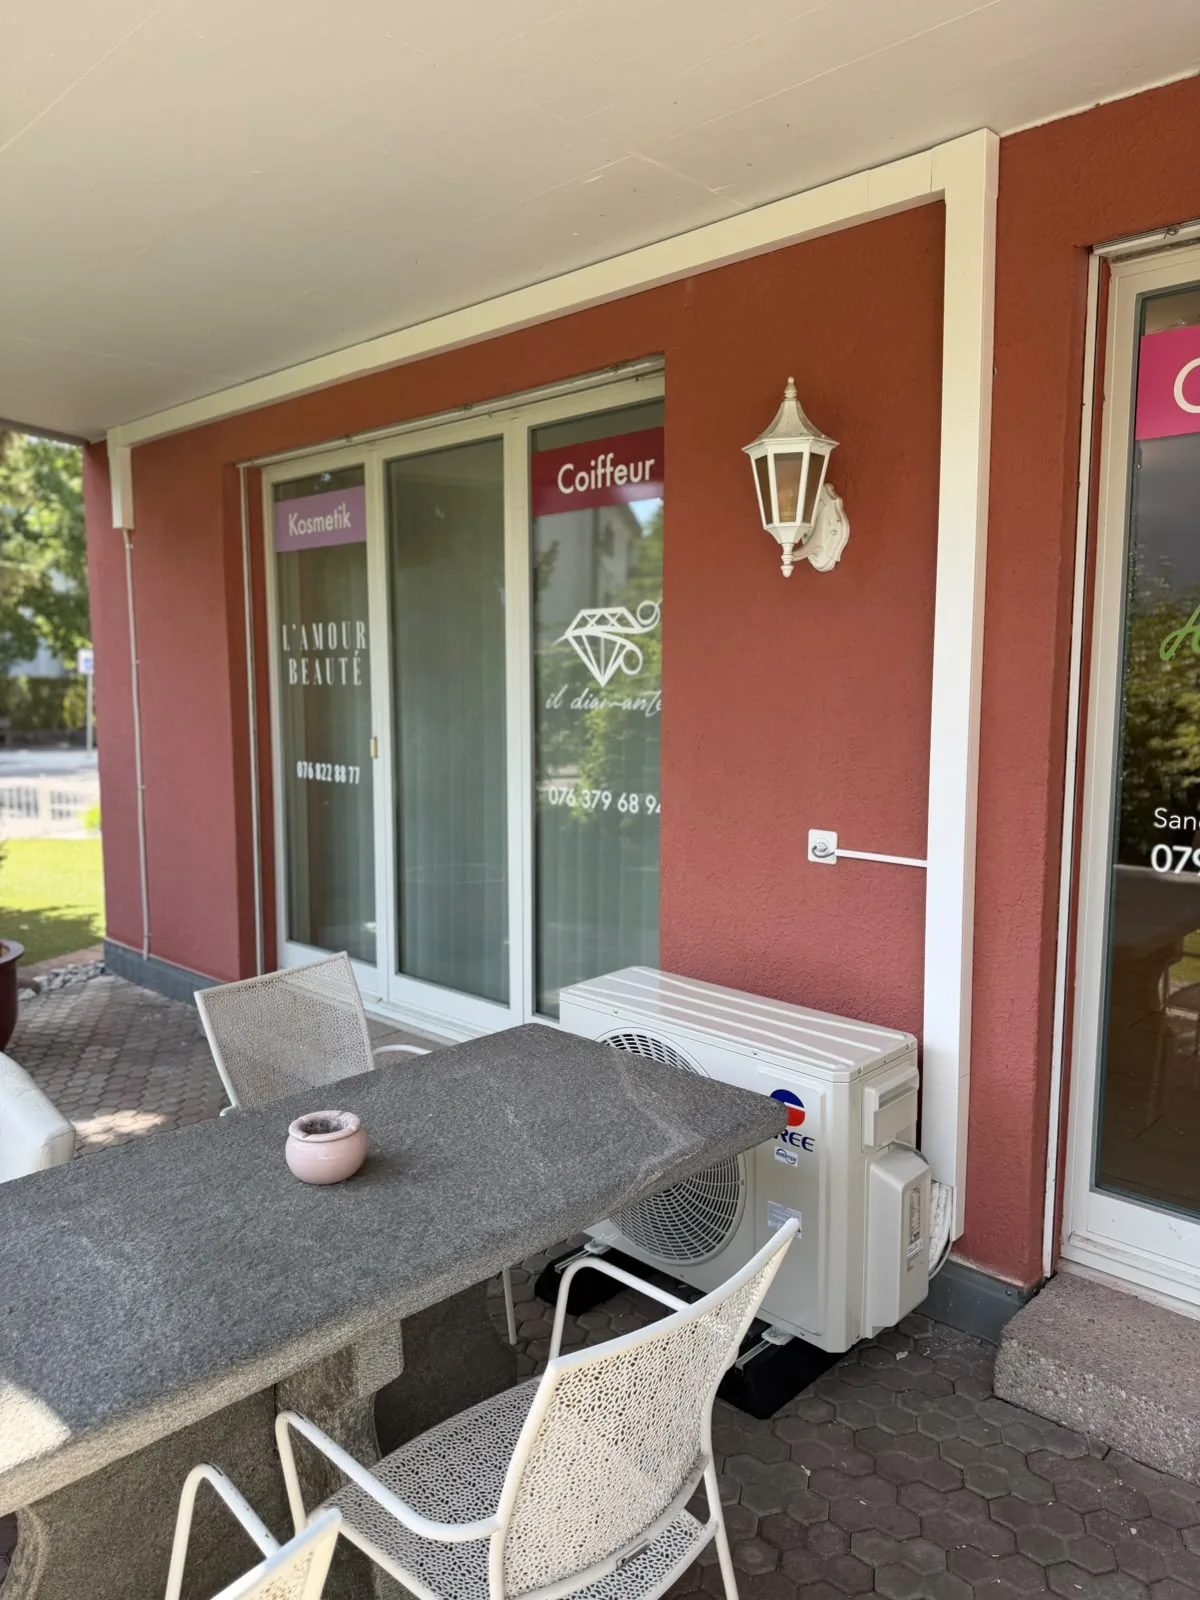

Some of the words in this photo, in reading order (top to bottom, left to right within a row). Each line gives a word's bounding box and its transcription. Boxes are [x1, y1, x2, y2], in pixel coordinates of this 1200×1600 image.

[557, 452, 655, 494] Coiffeur
[288, 501, 351, 536] Kosmetik
[282, 620, 366, 651] L'AMOUR
[288, 650, 362, 686] BEAUTÉ
[296, 760, 314, 779] 076
[315, 762, 332, 781] 822
[334, 764, 346, 783] 88
[347, 765, 360, 784] 77
[548, 786, 577, 808] 076
[580, 788, 612, 811] 379
[617, 792, 639, 813] 68
[1153, 806, 1200, 831] San
[774, 1128, 816, 1153] REE
